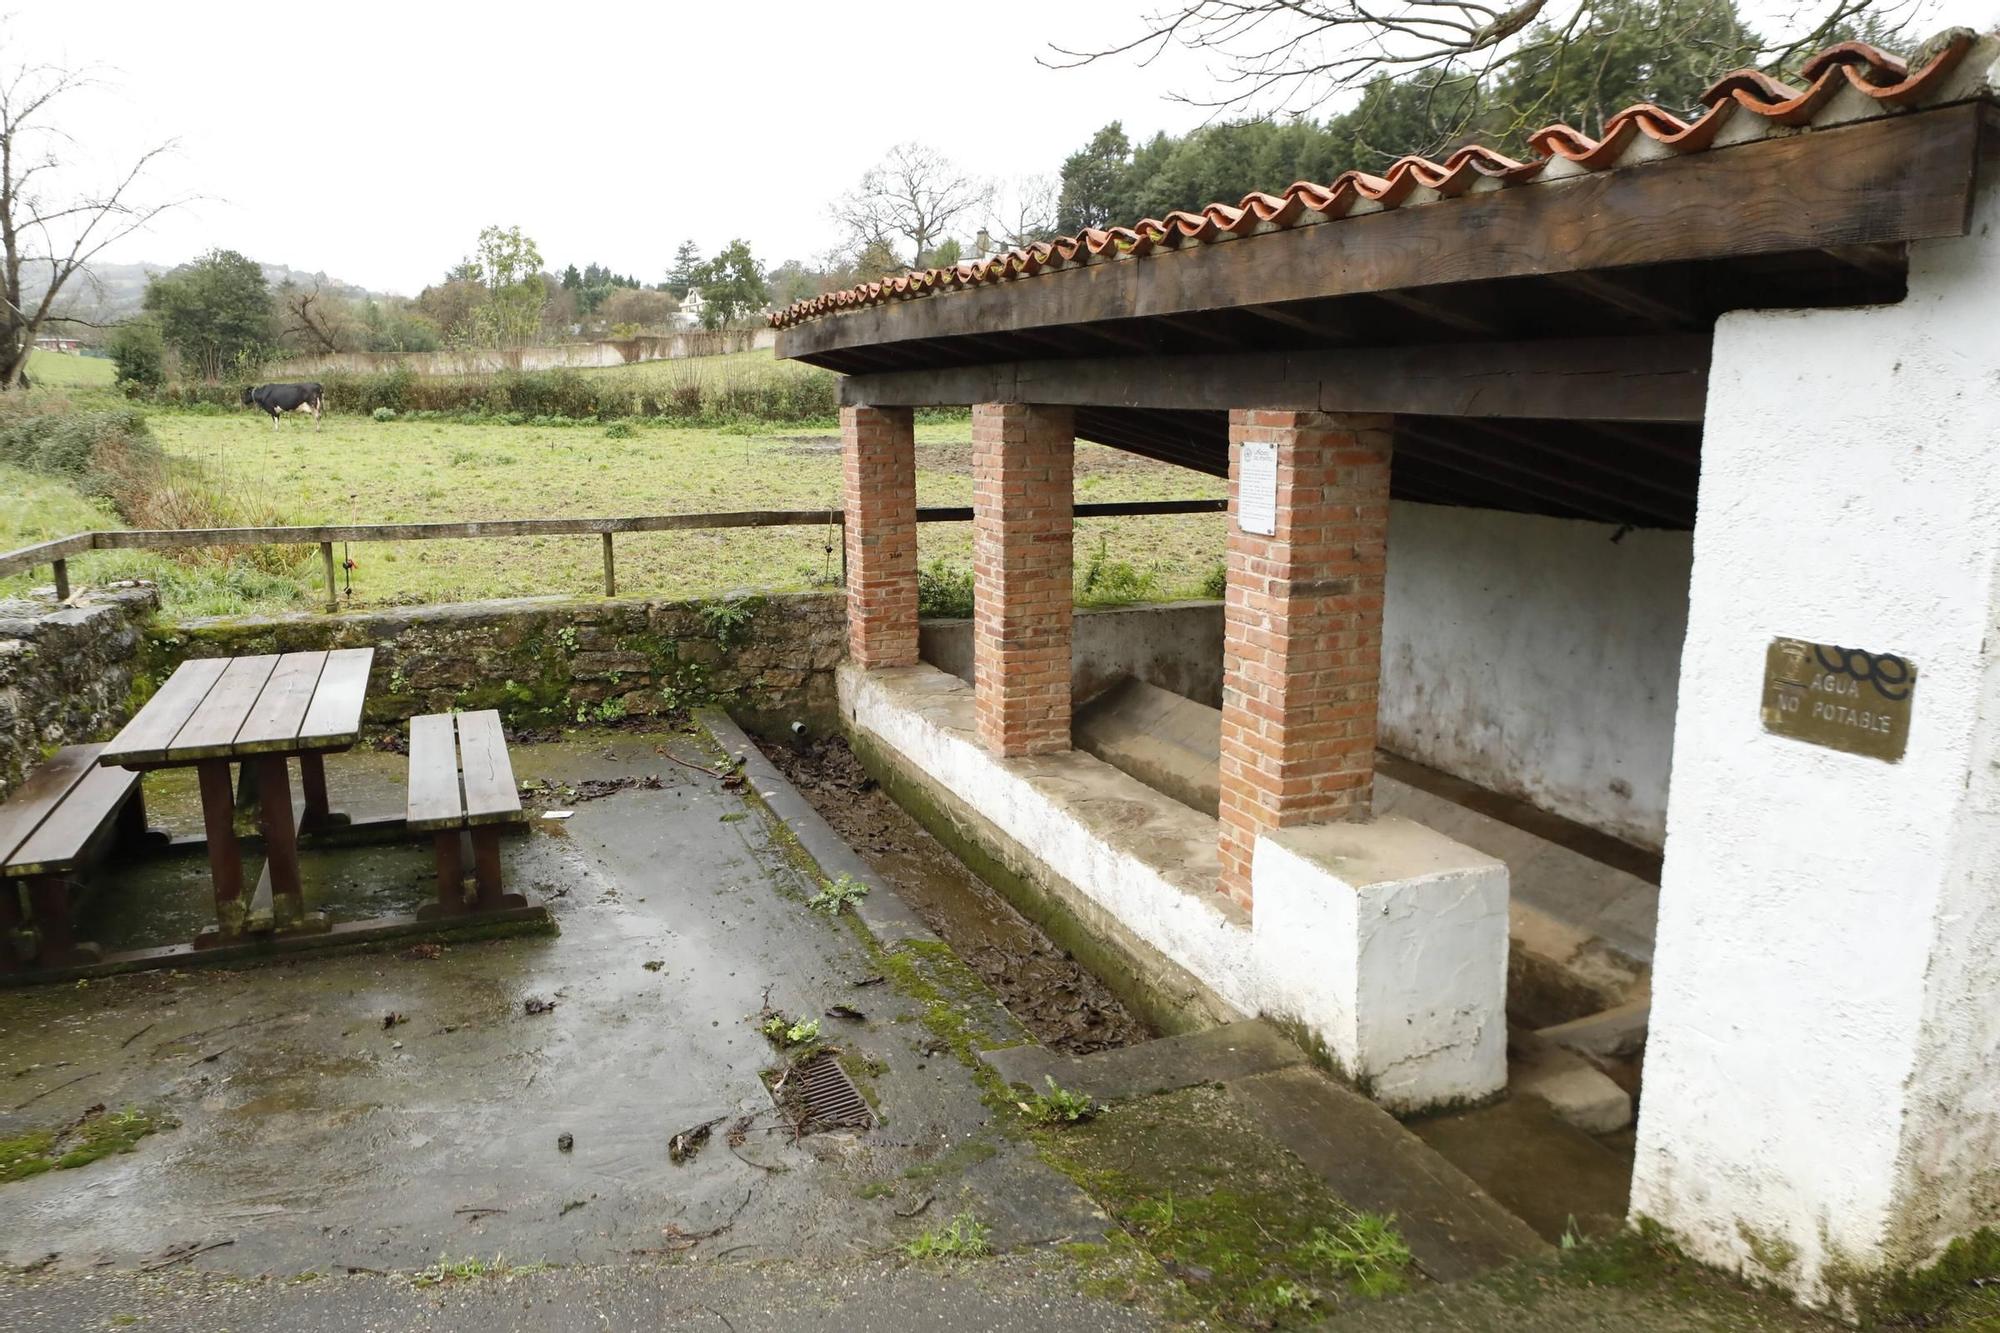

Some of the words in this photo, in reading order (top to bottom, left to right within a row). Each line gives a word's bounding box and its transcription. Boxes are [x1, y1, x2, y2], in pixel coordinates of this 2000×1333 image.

[1810, 673, 1860, 698] AGUA
[1778, 694, 1800, 713] NO
[1812, 701, 1892, 733] POTABLE
